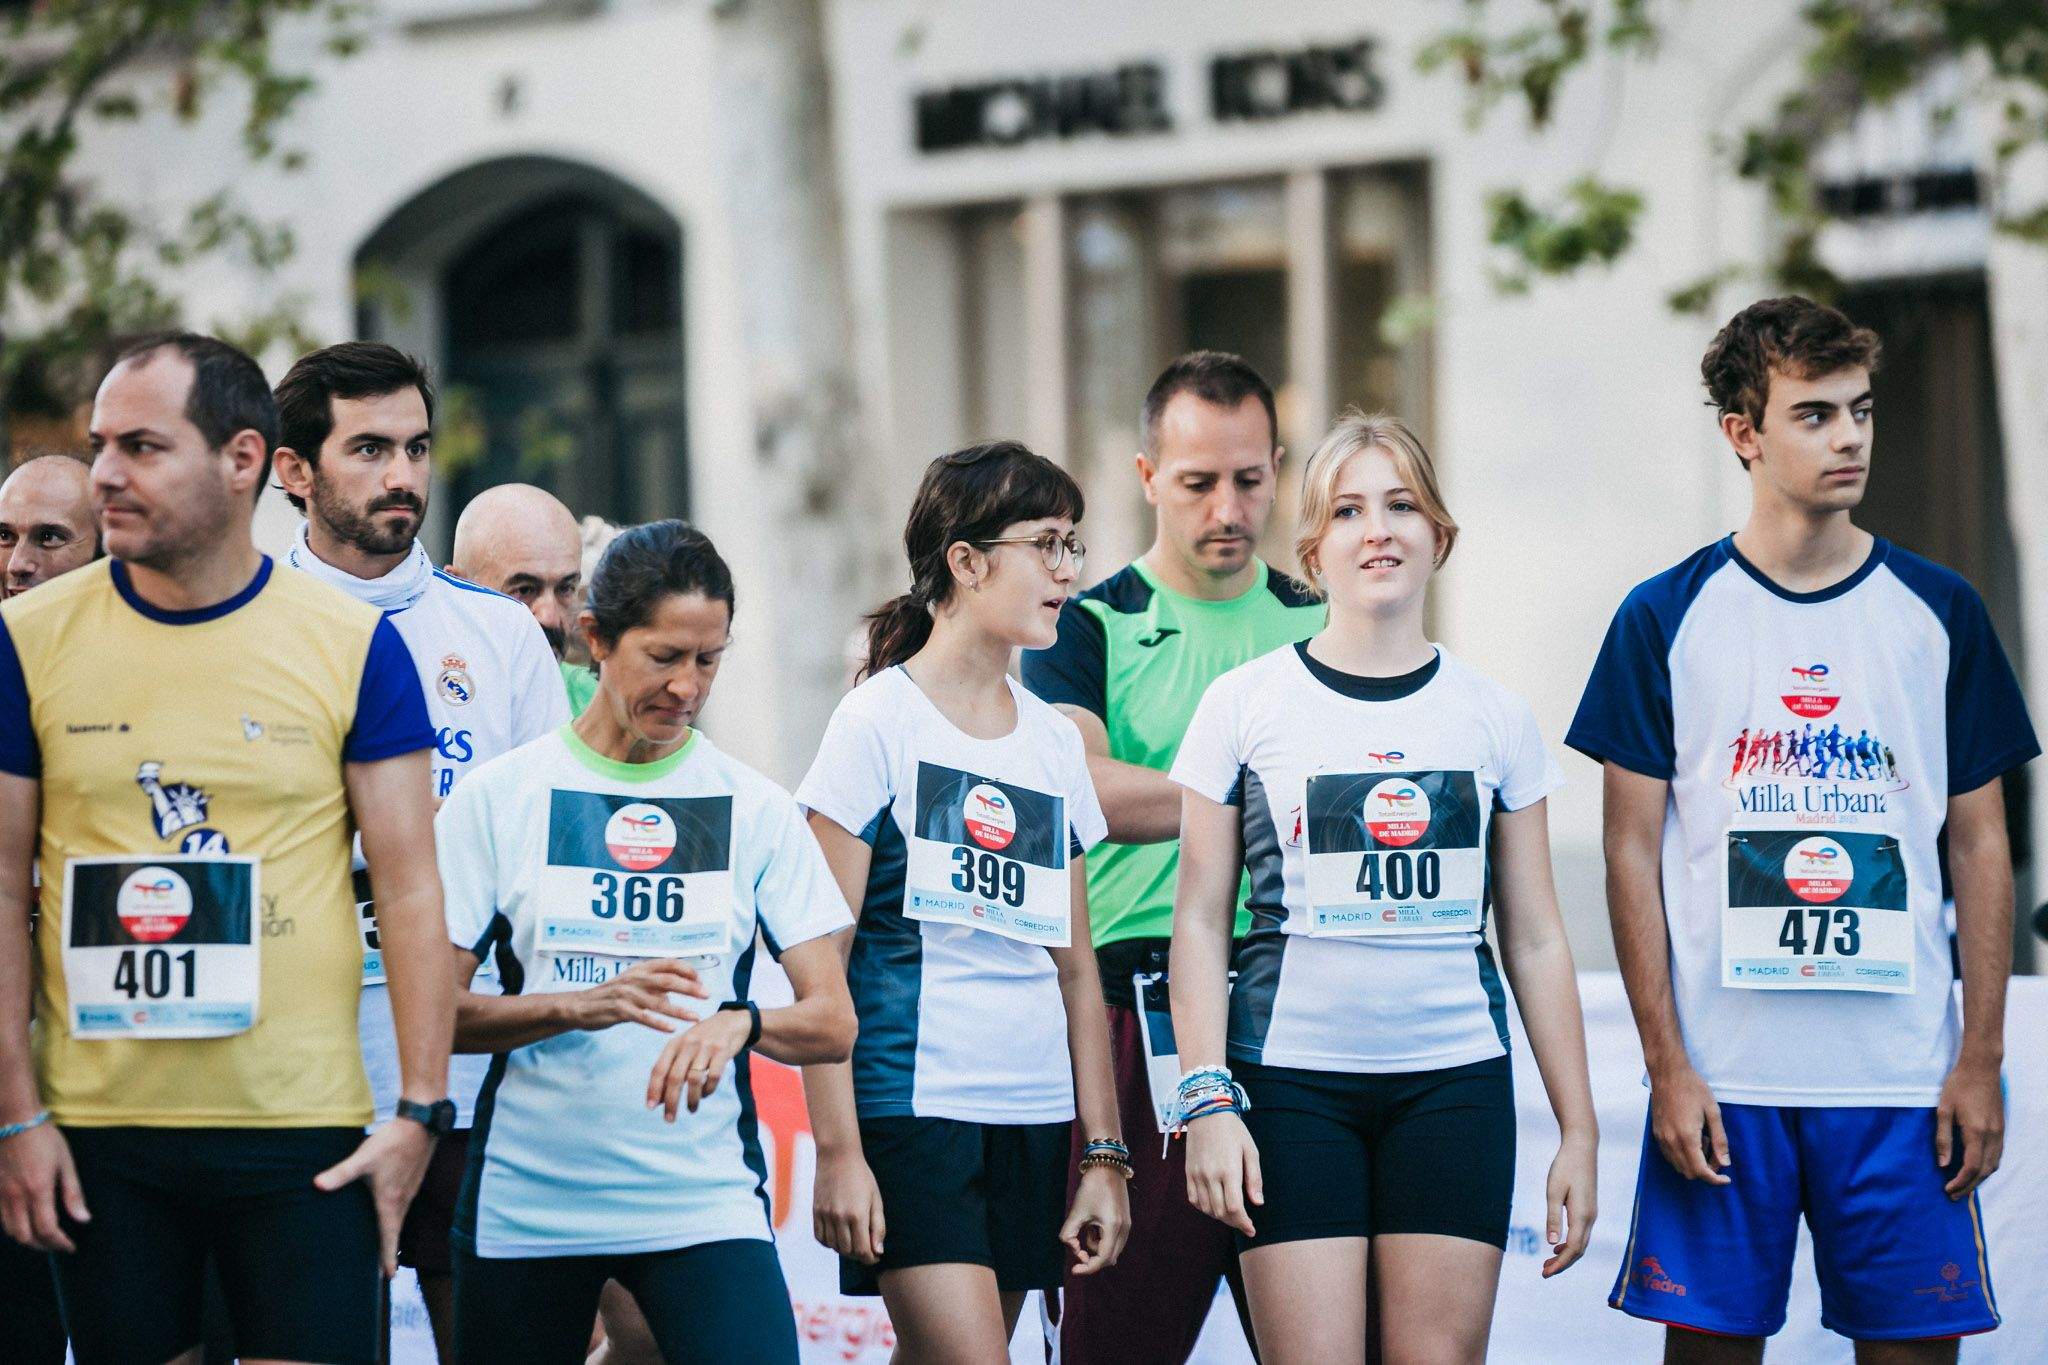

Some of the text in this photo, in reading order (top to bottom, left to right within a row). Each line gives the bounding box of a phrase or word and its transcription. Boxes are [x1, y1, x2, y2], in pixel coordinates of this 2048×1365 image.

[1736, 784, 1796, 813] Milla
[981, 825, 1000, 837] MILLA
[1379, 829, 1419, 838] DE MADRID
[1387, 822, 1411, 830] MILLA
[951, 846, 1026, 908] 399
[1355, 850, 1441, 901] 400
[591, 872, 685, 923] 366
[925, 899, 965, 911] MADRID
[1332, 912, 1372, 922] MADRID
[1779, 908, 1861, 957] 473
[114, 948, 196, 1000] 401
[552, 957, 606, 984] Milla
[1749, 967, 1789, 976] MADRID
